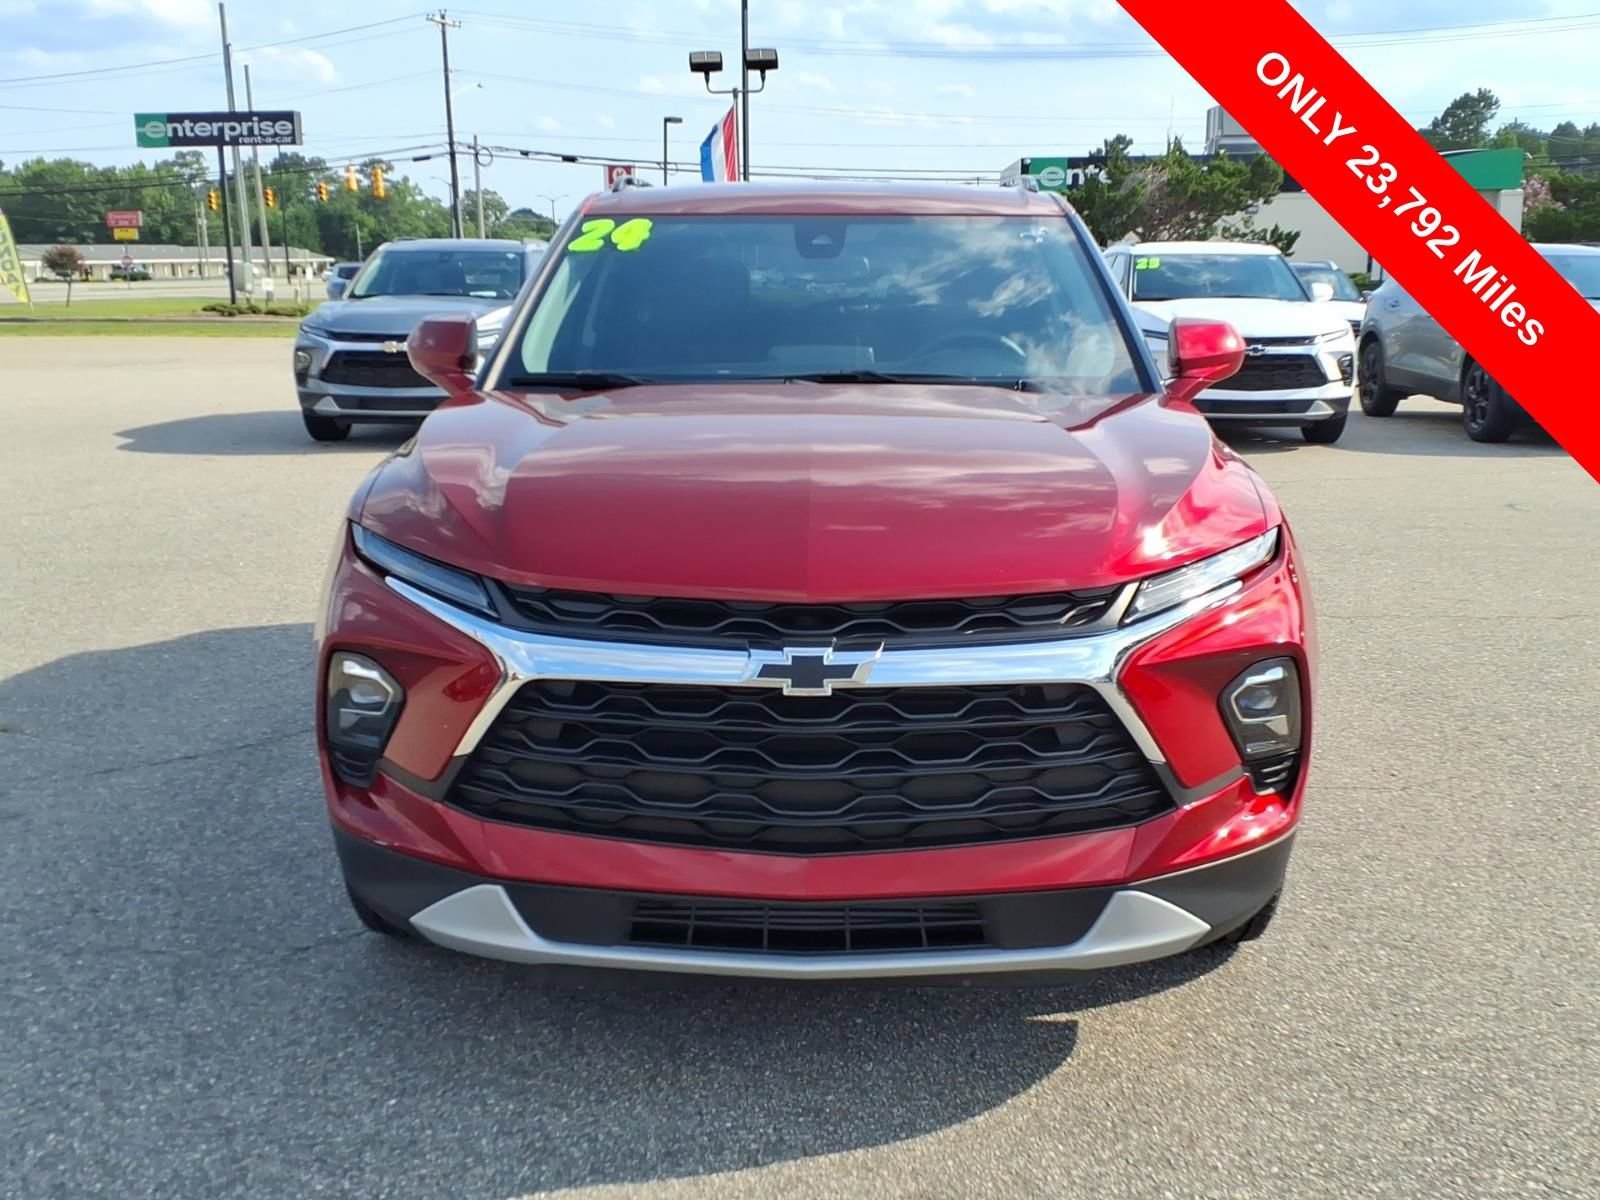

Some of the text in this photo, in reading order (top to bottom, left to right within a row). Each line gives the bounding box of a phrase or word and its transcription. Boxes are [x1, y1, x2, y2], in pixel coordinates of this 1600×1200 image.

[143, 117, 293, 142] enterprise
[238, 134, 293, 144] rent-a-car
[567, 218, 653, 252] 24
